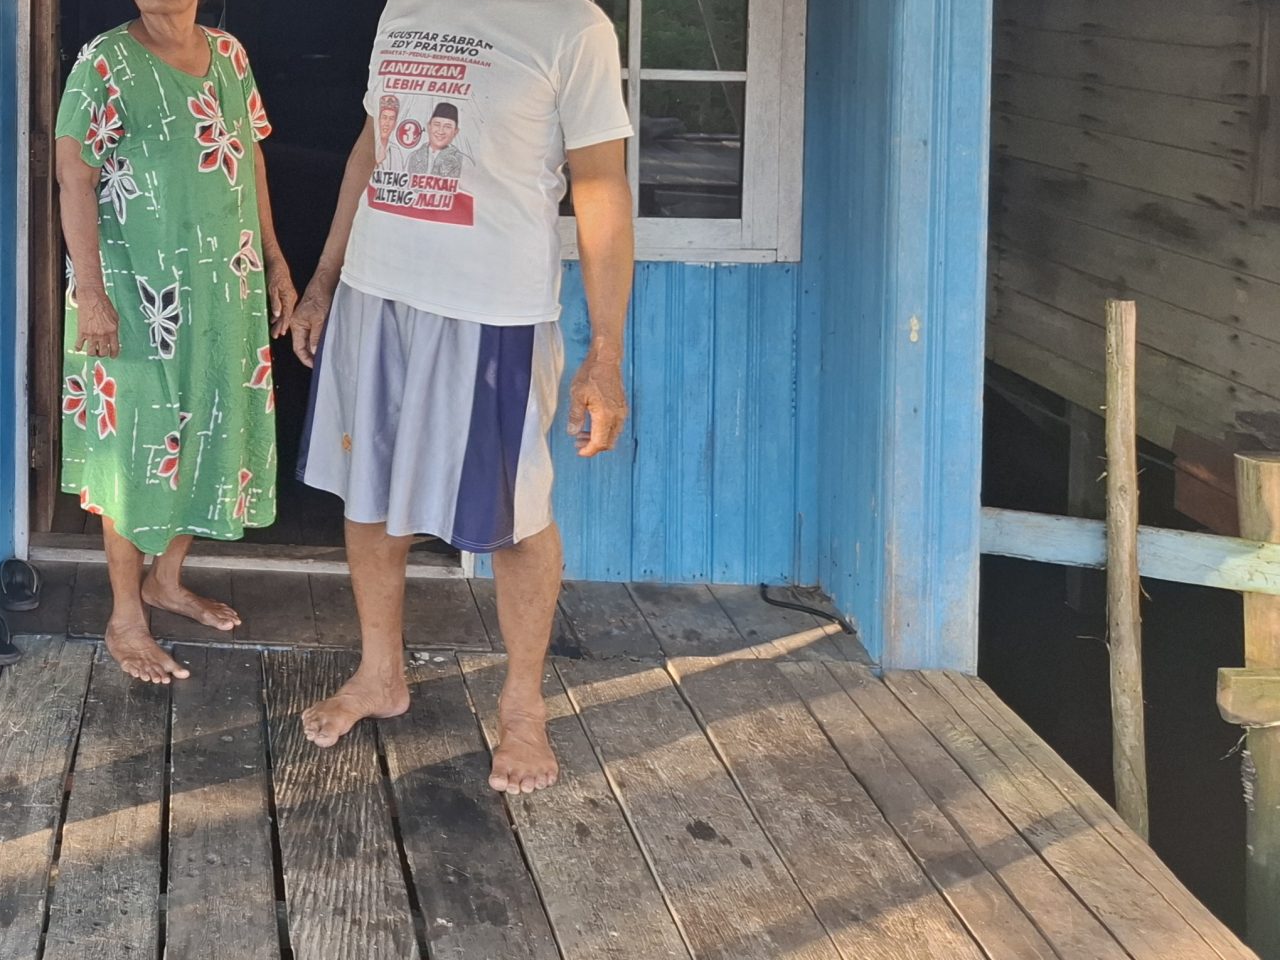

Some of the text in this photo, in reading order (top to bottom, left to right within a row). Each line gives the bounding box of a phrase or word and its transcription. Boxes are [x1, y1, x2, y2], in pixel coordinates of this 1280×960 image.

[387, 31, 494, 50] AGUSTIAR SABRAN
[391, 40, 479, 57] EDY PRATOWO
[380, 61, 463, 80] LANJUTKAN,
[385, 78, 471, 95] LEBIH BAIK!
[402, 123, 416, 144] 3
[411, 175, 458, 192] BERKAH
[375, 188, 452, 208] ALTENG MAJU
